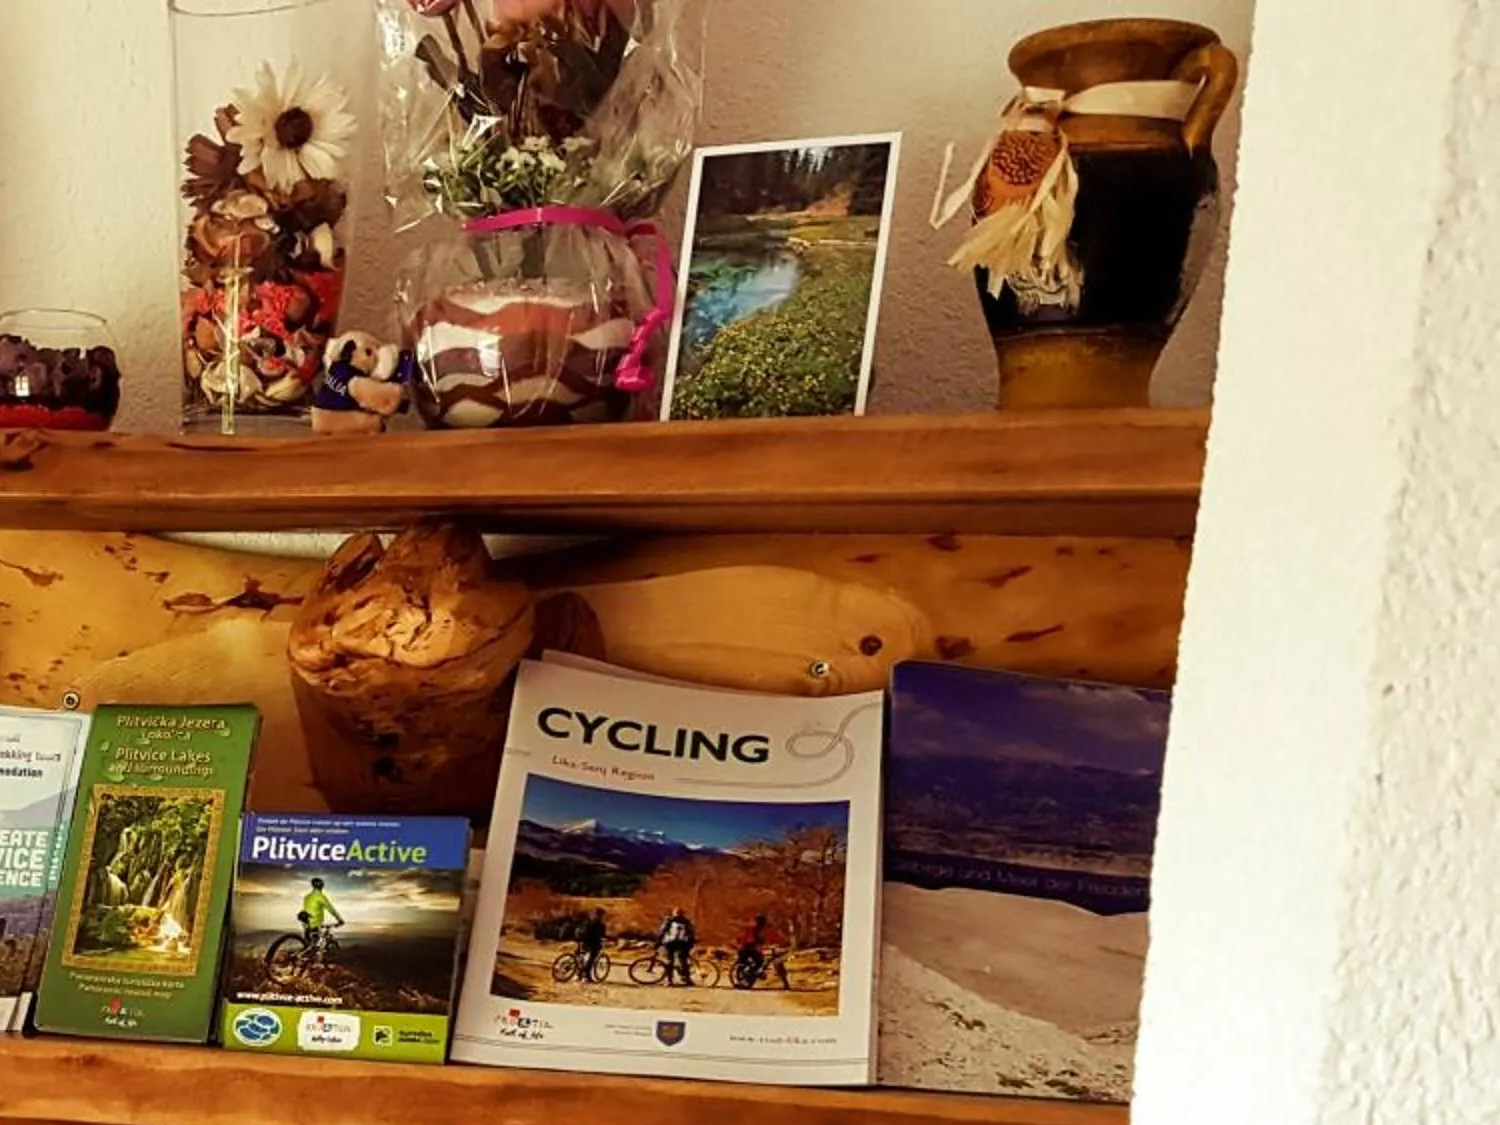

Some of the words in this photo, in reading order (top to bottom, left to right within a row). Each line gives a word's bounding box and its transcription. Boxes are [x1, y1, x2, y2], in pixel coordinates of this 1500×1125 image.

[537, 707, 770, 764] CYCLING
[115, 746, 168, 761] Plitvice
[171, 747, 212, 763] Lakes
